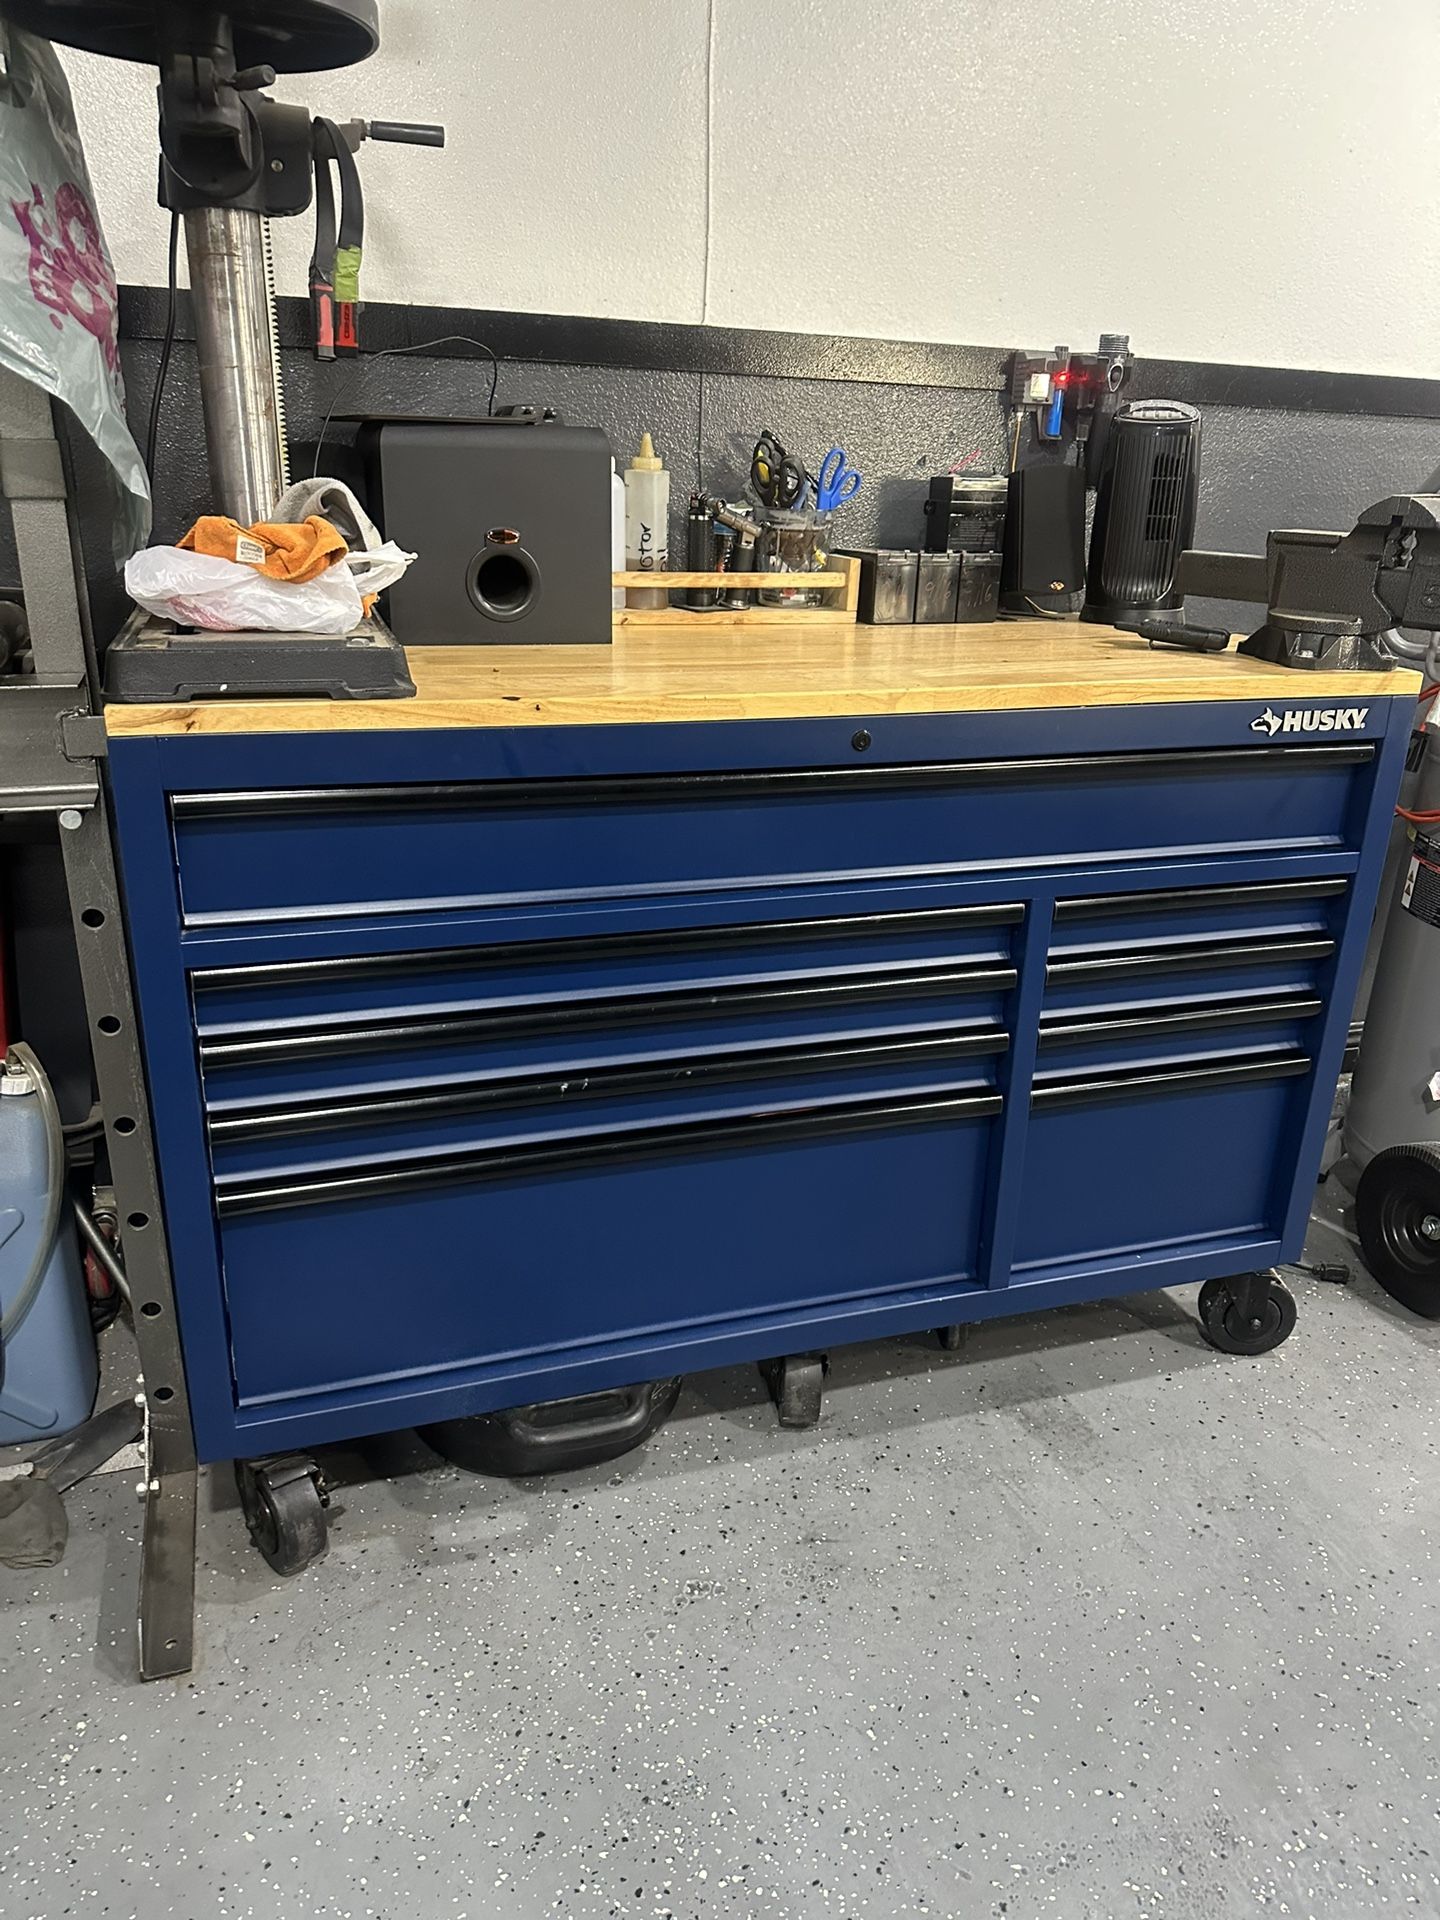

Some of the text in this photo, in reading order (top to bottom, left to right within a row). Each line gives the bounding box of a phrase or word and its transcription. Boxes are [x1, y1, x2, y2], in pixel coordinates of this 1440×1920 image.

[33, 243, 58, 300] the
[637, 522, 654, 572] otor
[1282, 708, 1369, 732] HUSKY
